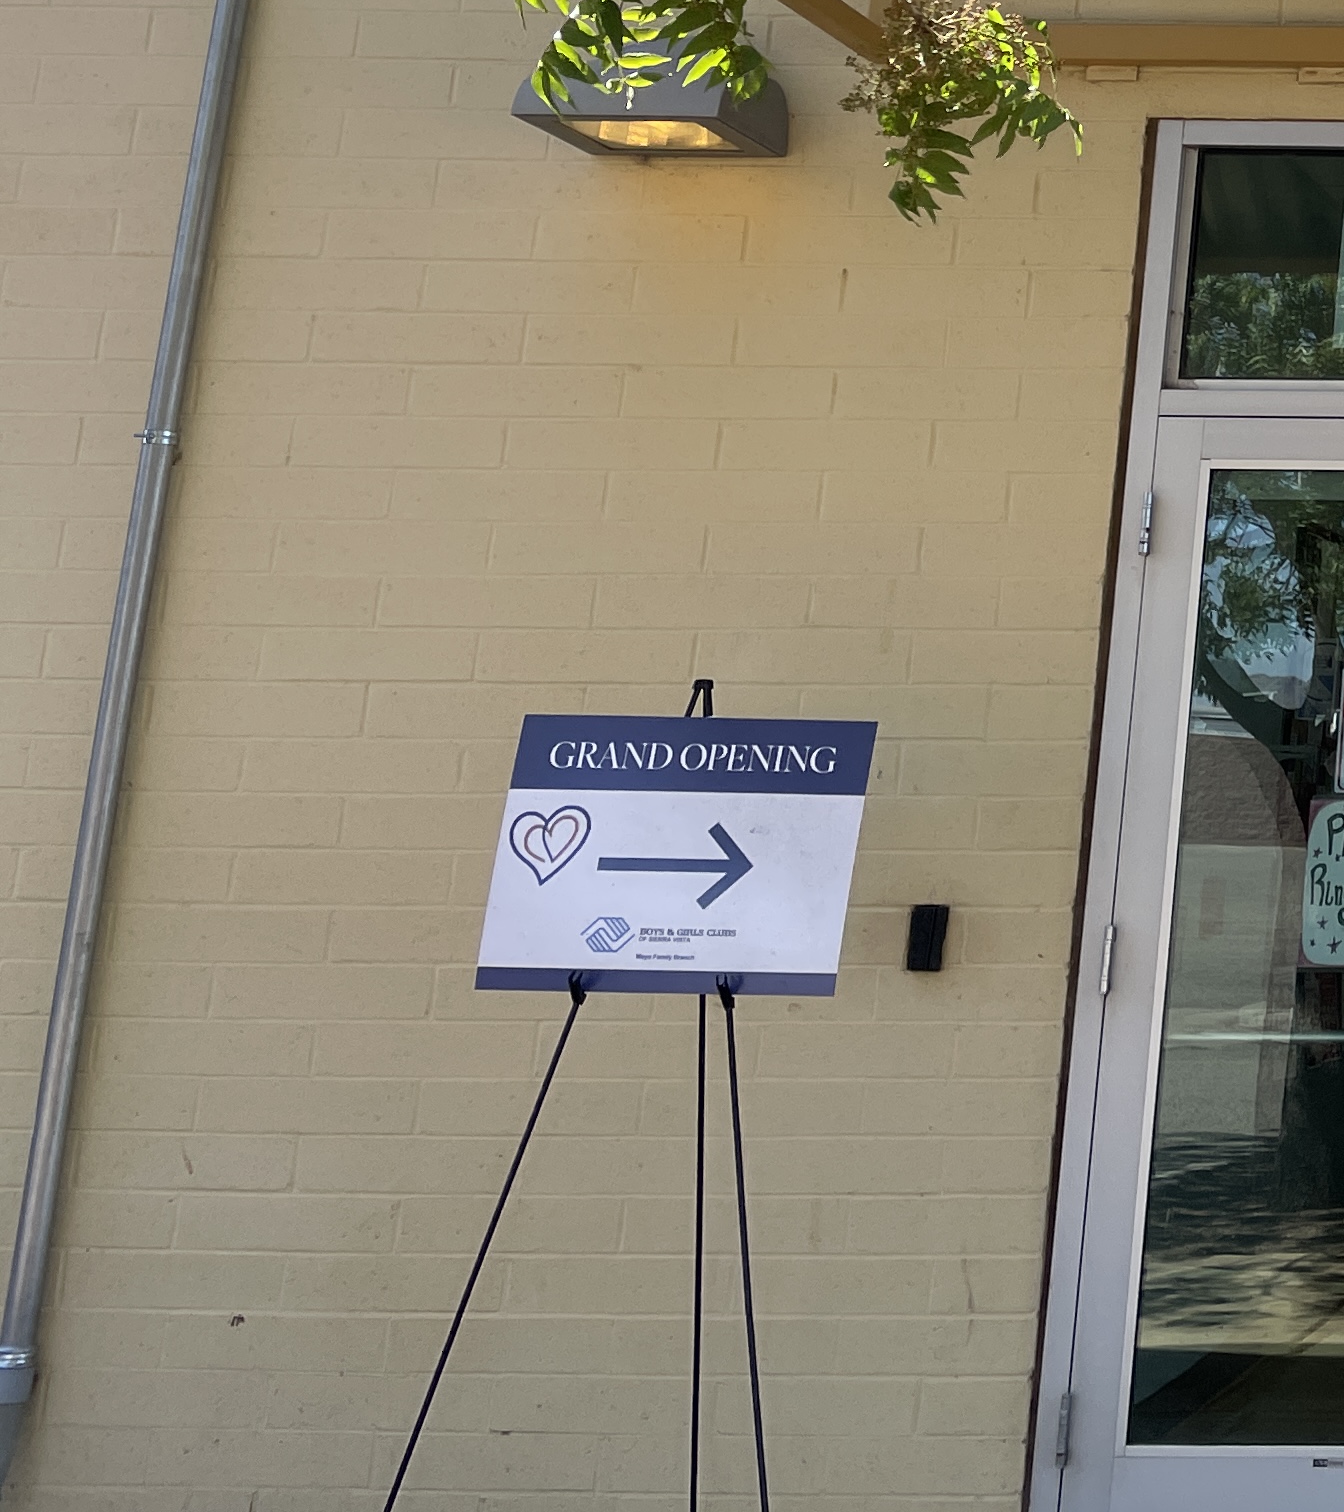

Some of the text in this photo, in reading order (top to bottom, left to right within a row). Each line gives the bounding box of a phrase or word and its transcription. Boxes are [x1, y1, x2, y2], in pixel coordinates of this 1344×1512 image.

[549, 741, 838, 775] GRAND OPENING
[640, 927, 664, 936] BOYS
